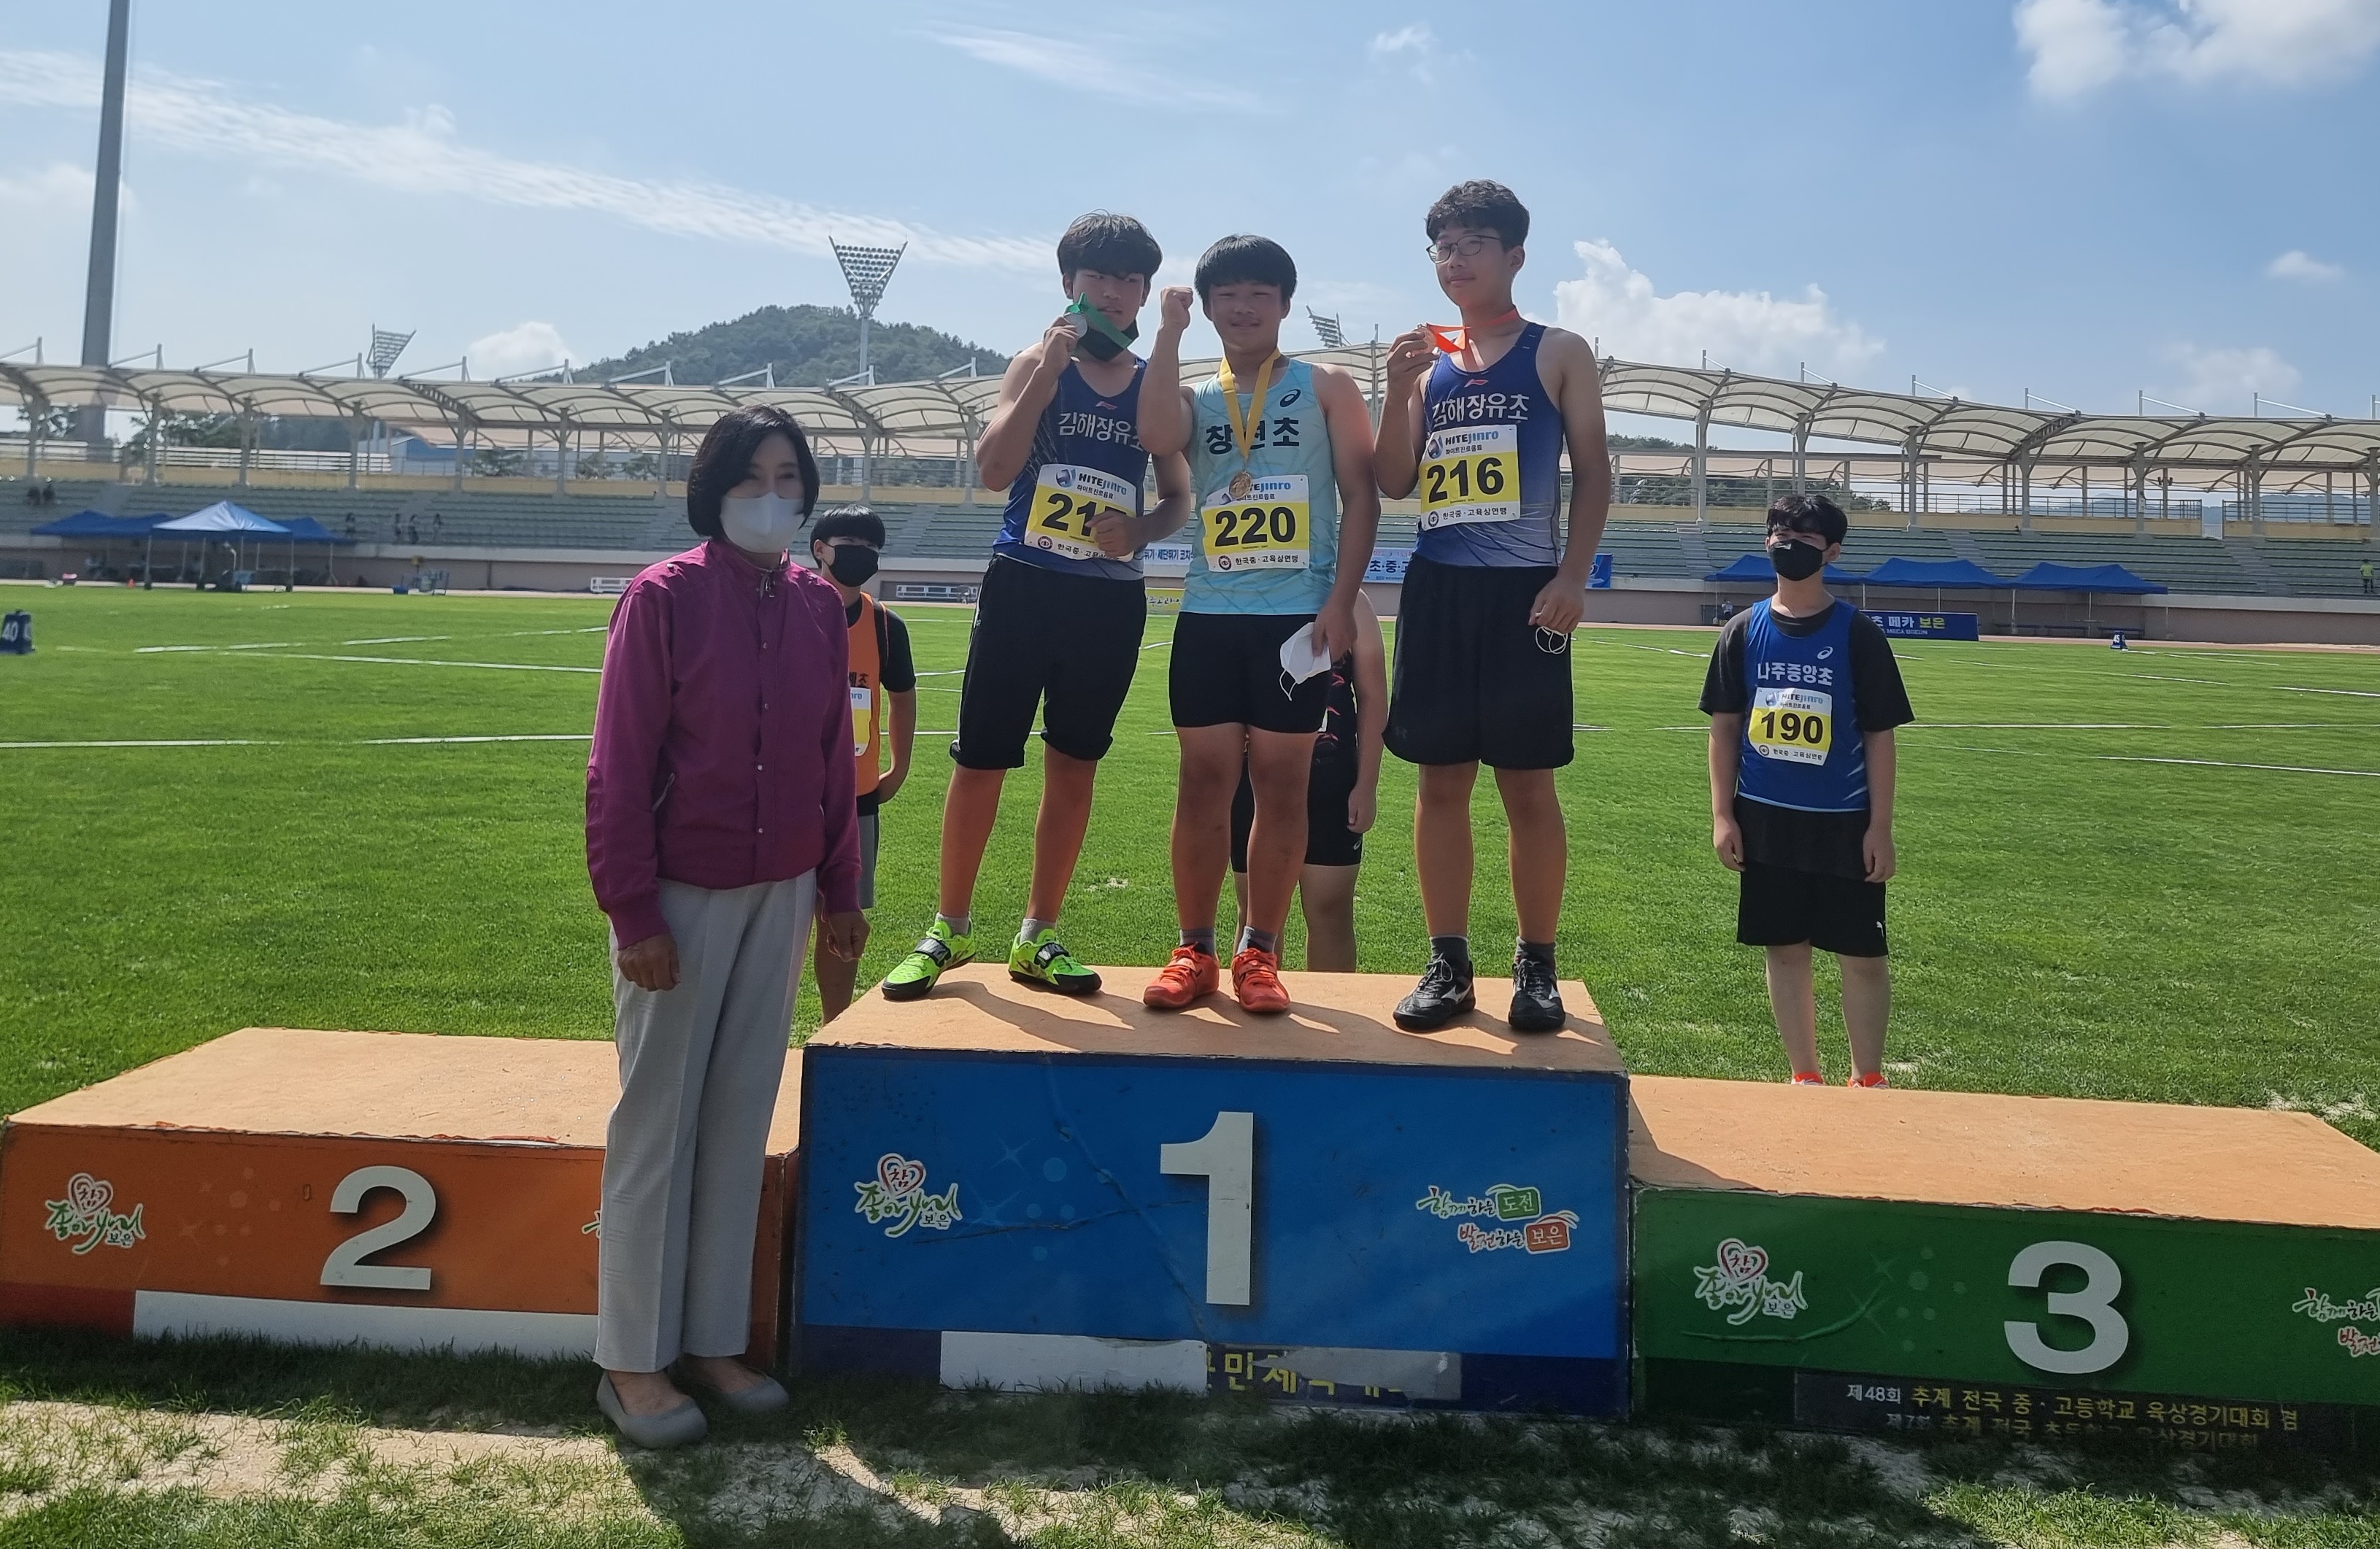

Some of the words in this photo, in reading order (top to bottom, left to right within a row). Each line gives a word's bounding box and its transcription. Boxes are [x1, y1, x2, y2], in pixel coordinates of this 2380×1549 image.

[1432, 393, 1530, 428] 김해장유초
[1426, 457, 1504, 503] 216
[1041, 493, 1128, 538] 21
[1214, 506, 1296, 547] 220
[1888, 616, 1915, 628] 메카
[1919, 617, 1946, 630] 보은
[1757, 662, 1833, 687] 나주중앙초
[1760, 711, 1824, 744] 190
[888, 1167, 910, 1188] 참
[1160, 1110, 1255, 1306] 1
[1502, 1191, 1534, 1213] 도전
[319, 1164, 436, 1290] 2
[921, 1213, 949, 1228] 보은
[1530, 1225, 1563, 1245] 보은
[2003, 1240, 2130, 1375] 3
[2339, 1328, 2380, 1355] 발전
[1846, 1384, 1901, 1405] 제48회
[1911, 1386, 1951, 1409] 추계
[1962, 1389, 2002, 1413] 전국
[2146, 1401, 2270, 1429] 육상경기대회
